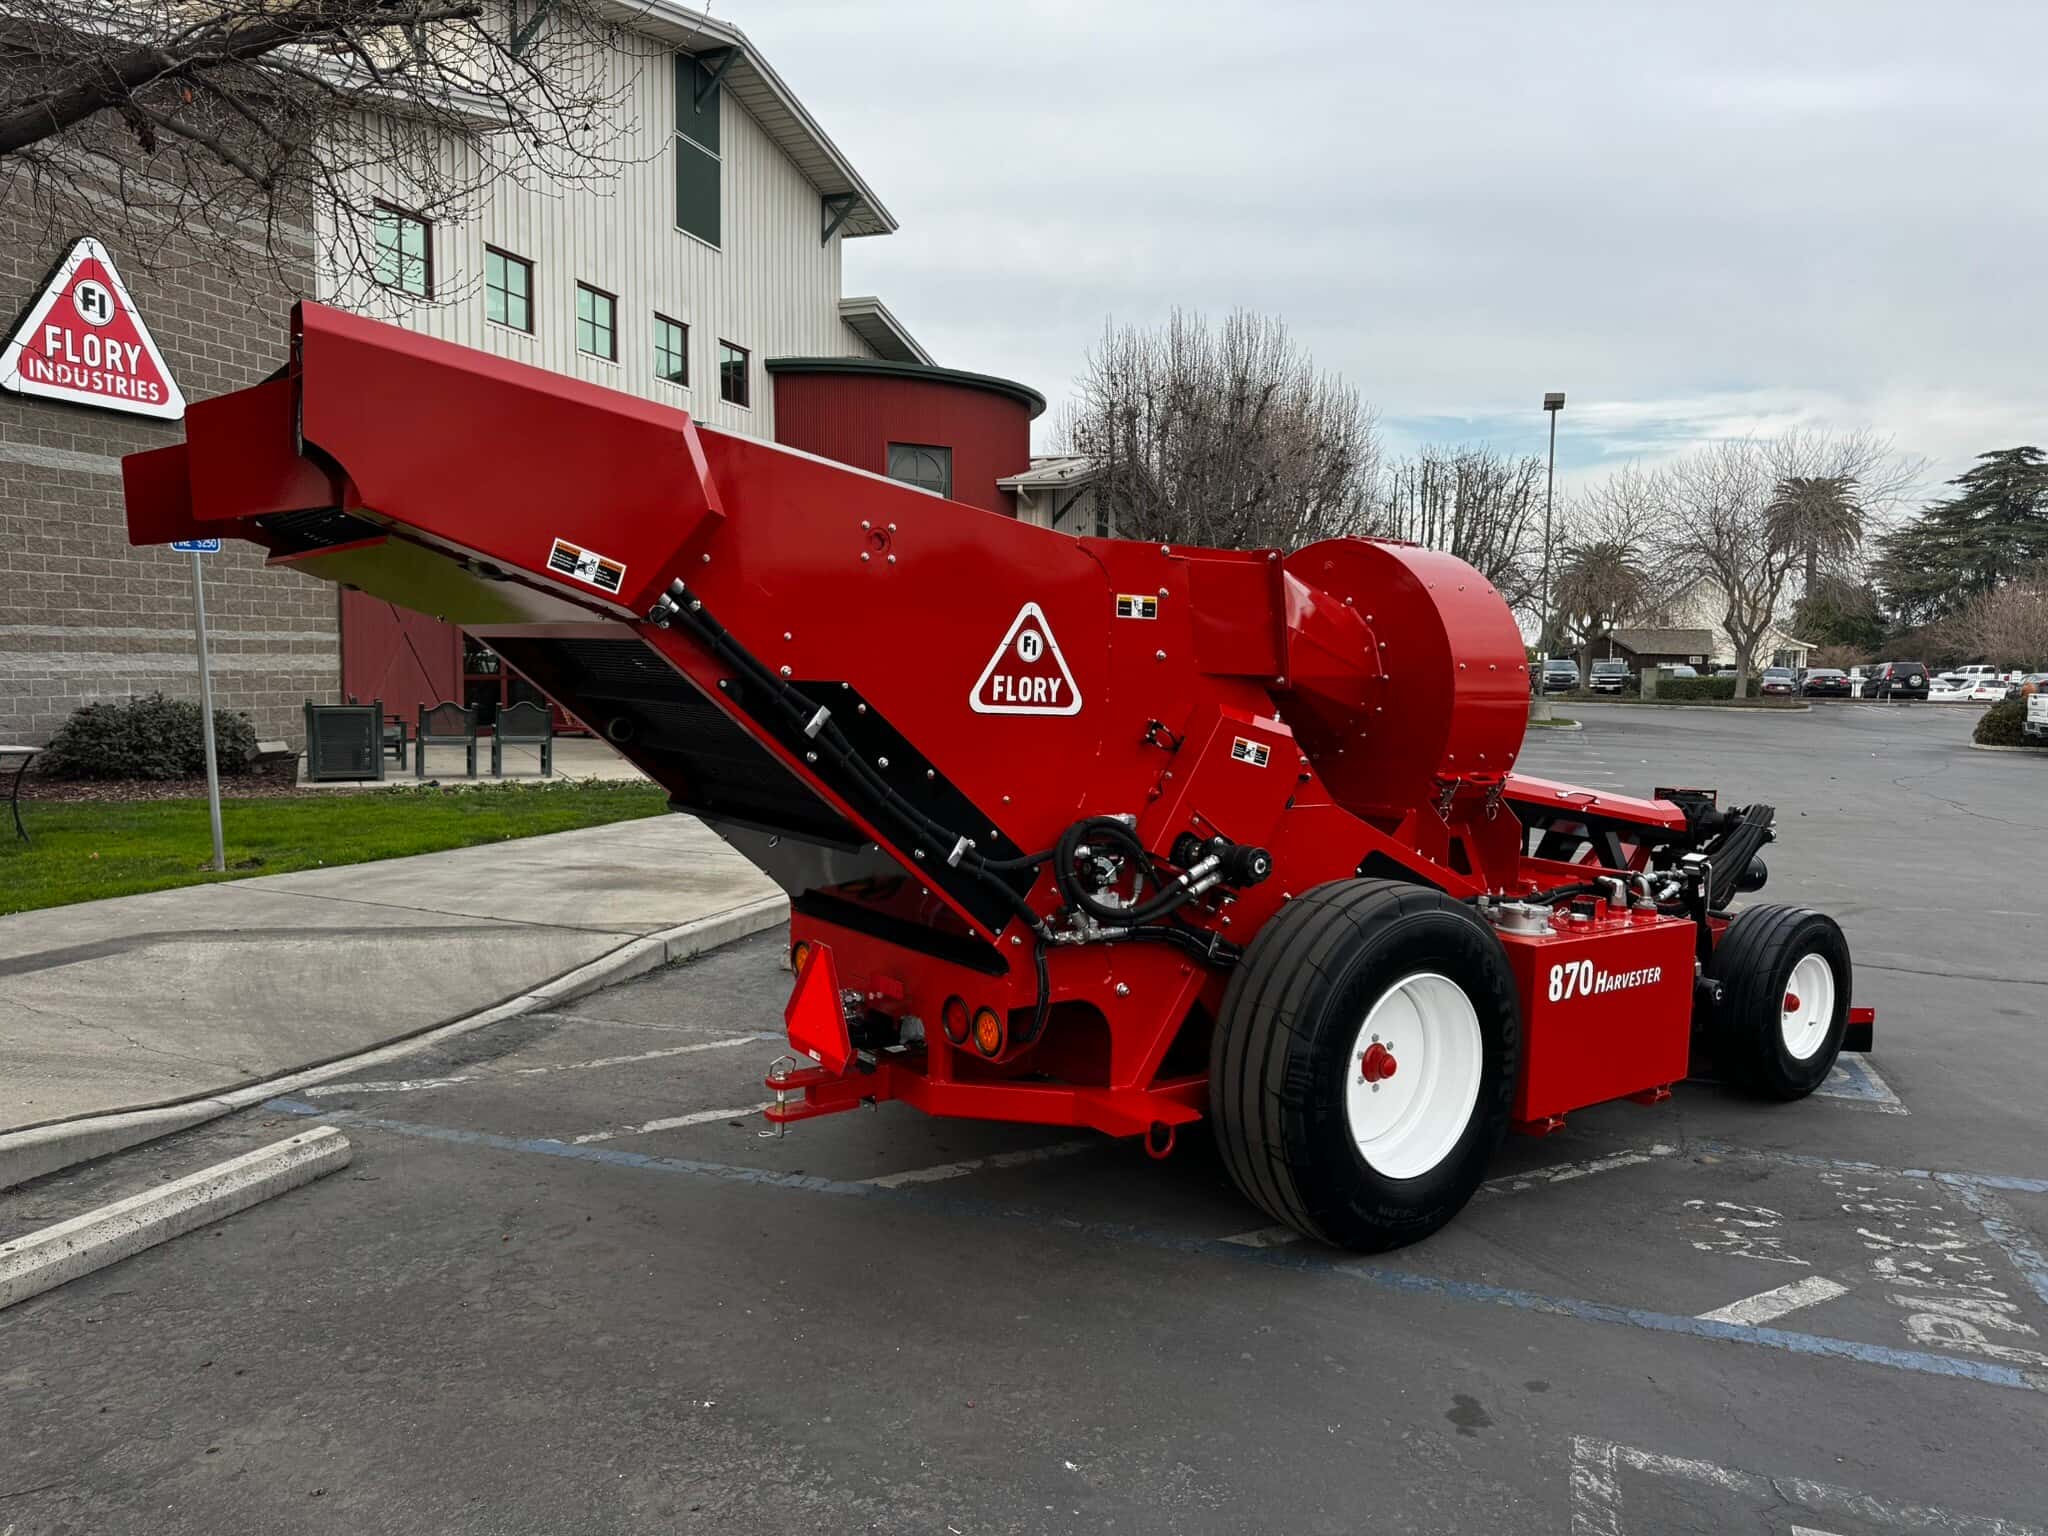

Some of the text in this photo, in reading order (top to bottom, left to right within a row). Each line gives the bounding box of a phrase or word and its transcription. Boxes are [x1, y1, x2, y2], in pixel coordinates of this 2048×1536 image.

[81, 286, 106, 319] FI
[44, 324, 143, 376] FLORY
[27, 357, 161, 402] INDUSTRIES
[1023, 635, 1037, 656] FI
[992, 675, 1062, 703] FLORY
[1548, 959, 1661, 1002] 870 HARVESTER
